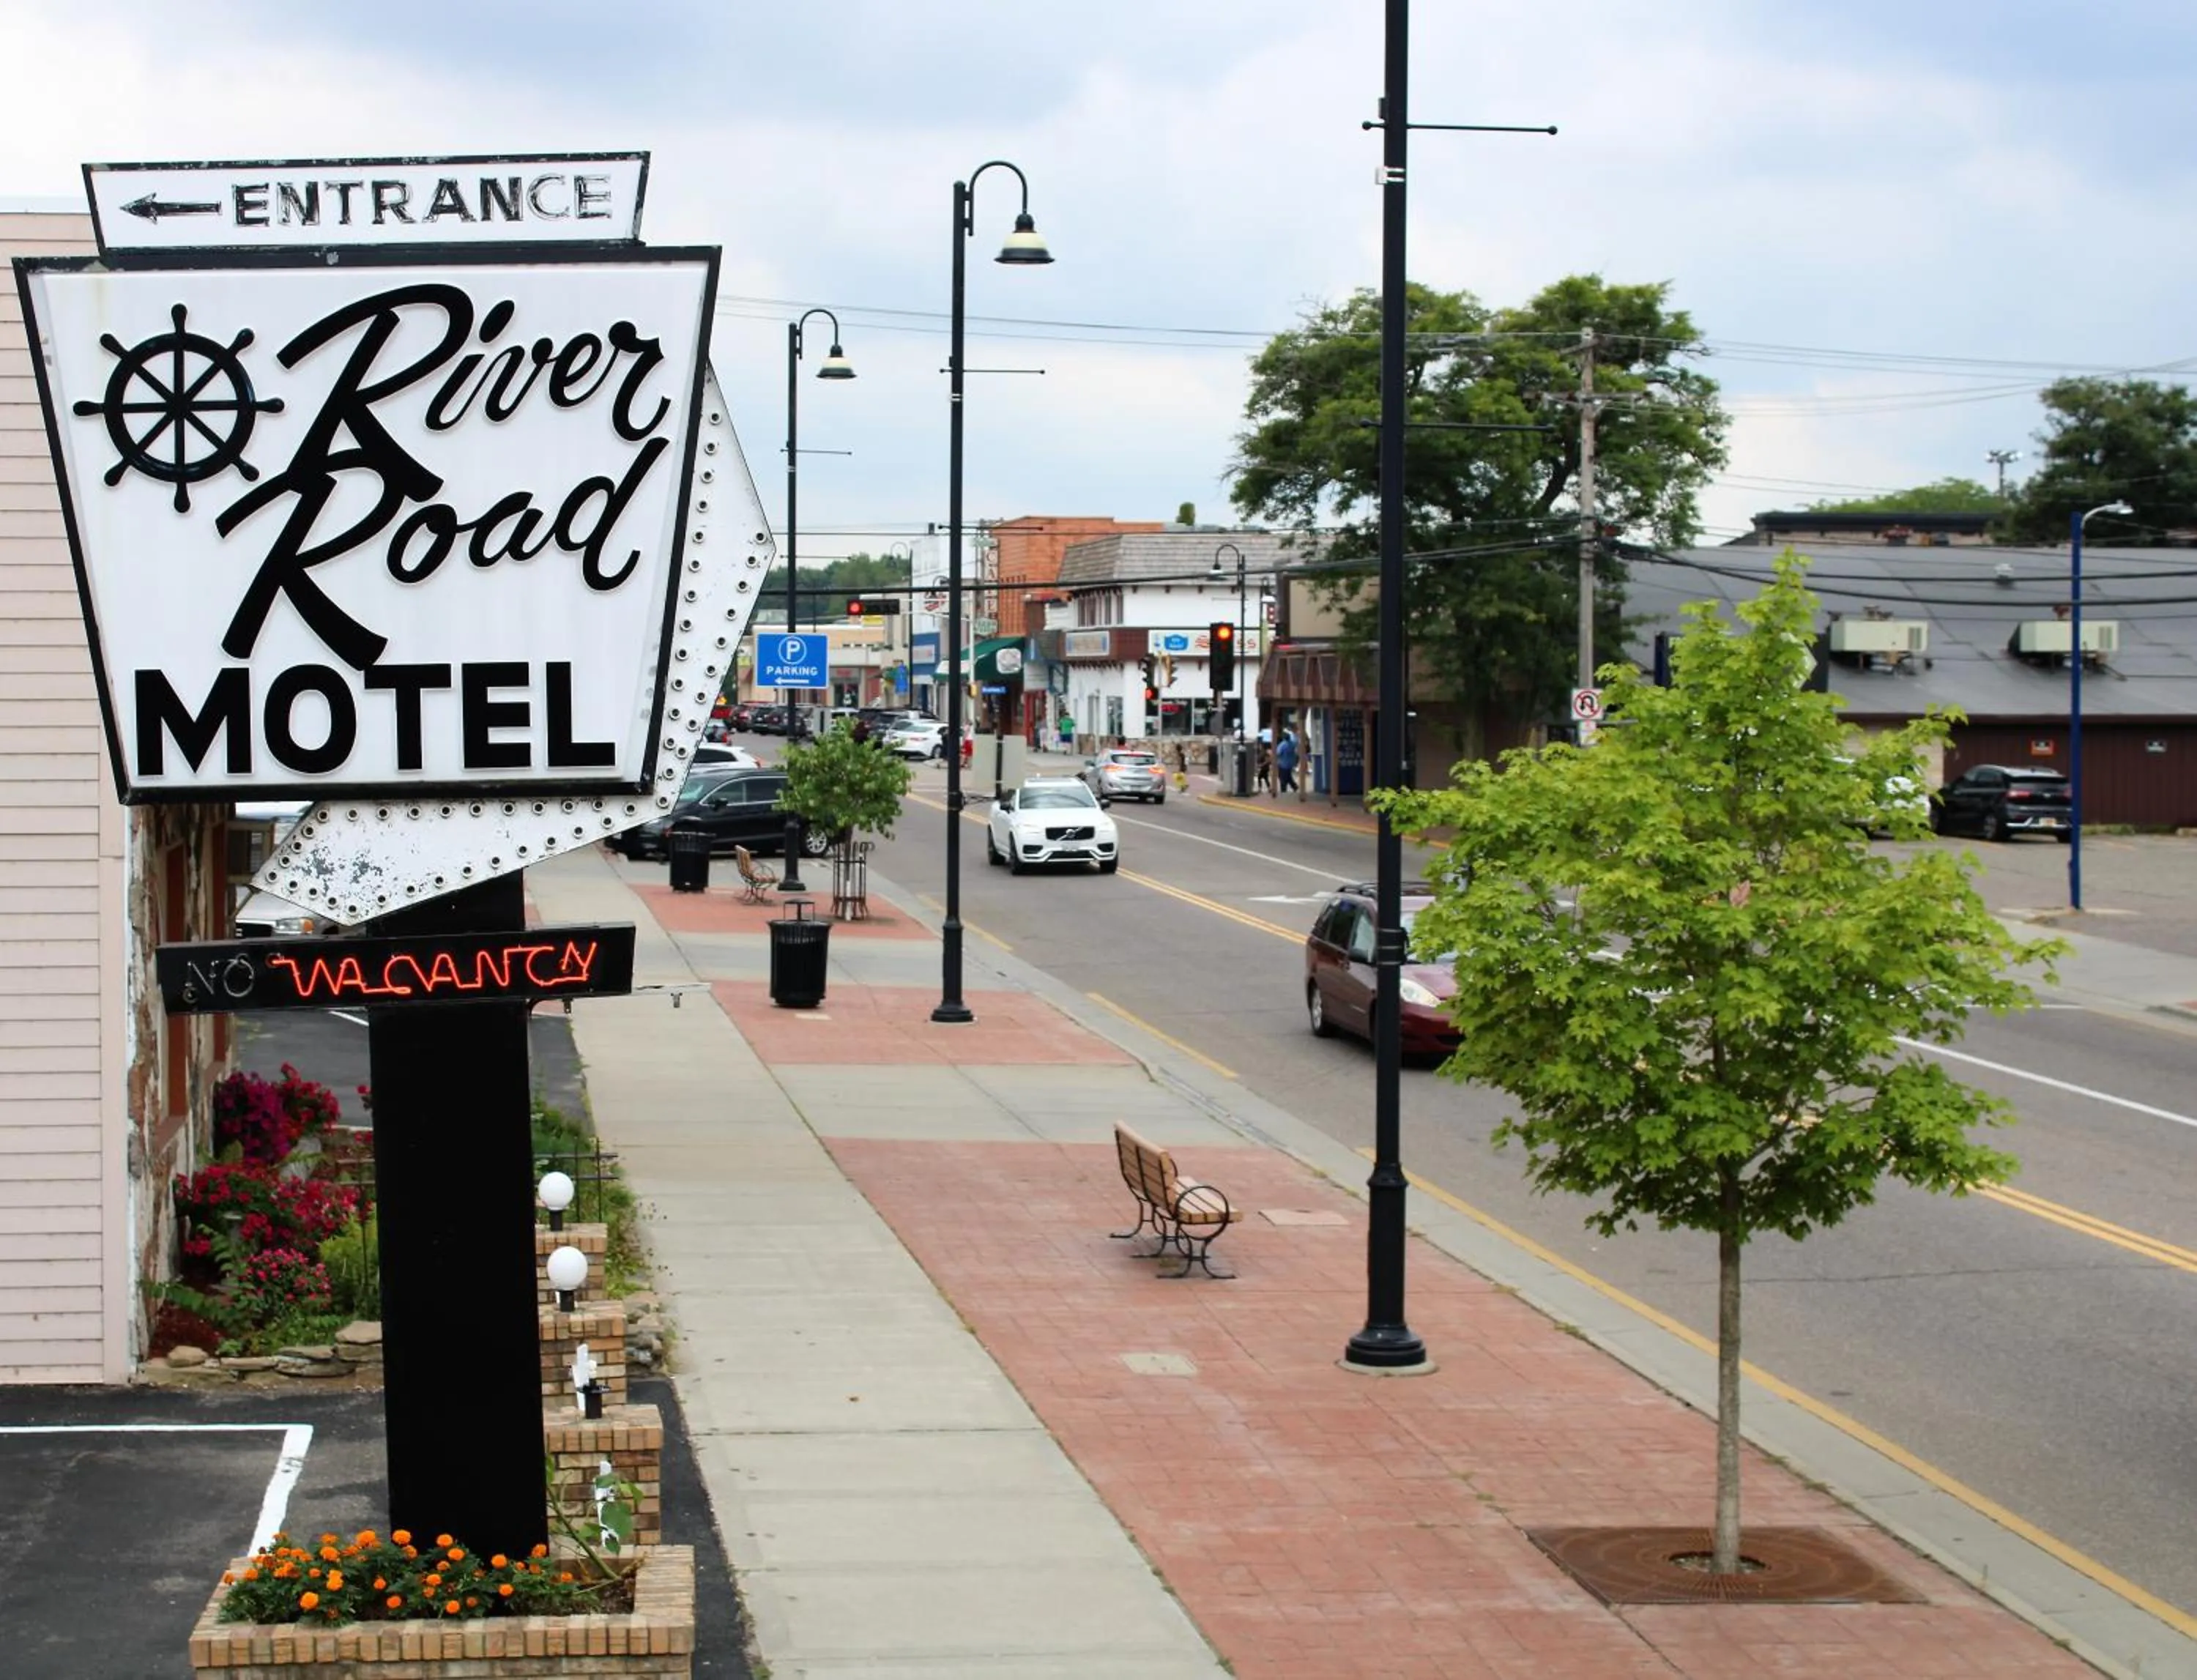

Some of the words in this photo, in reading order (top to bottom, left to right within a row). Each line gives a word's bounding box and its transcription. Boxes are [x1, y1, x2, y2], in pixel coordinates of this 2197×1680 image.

[231, 174, 613, 227] ENTRANCE
[276, 283, 672, 503] River
[215, 438, 669, 671] Road
[766, 665, 818, 677] PARKING
[135, 661, 617, 776] MOTEL
[185, 955, 256, 999] NO
[272, 940, 598, 997] VACANCY
